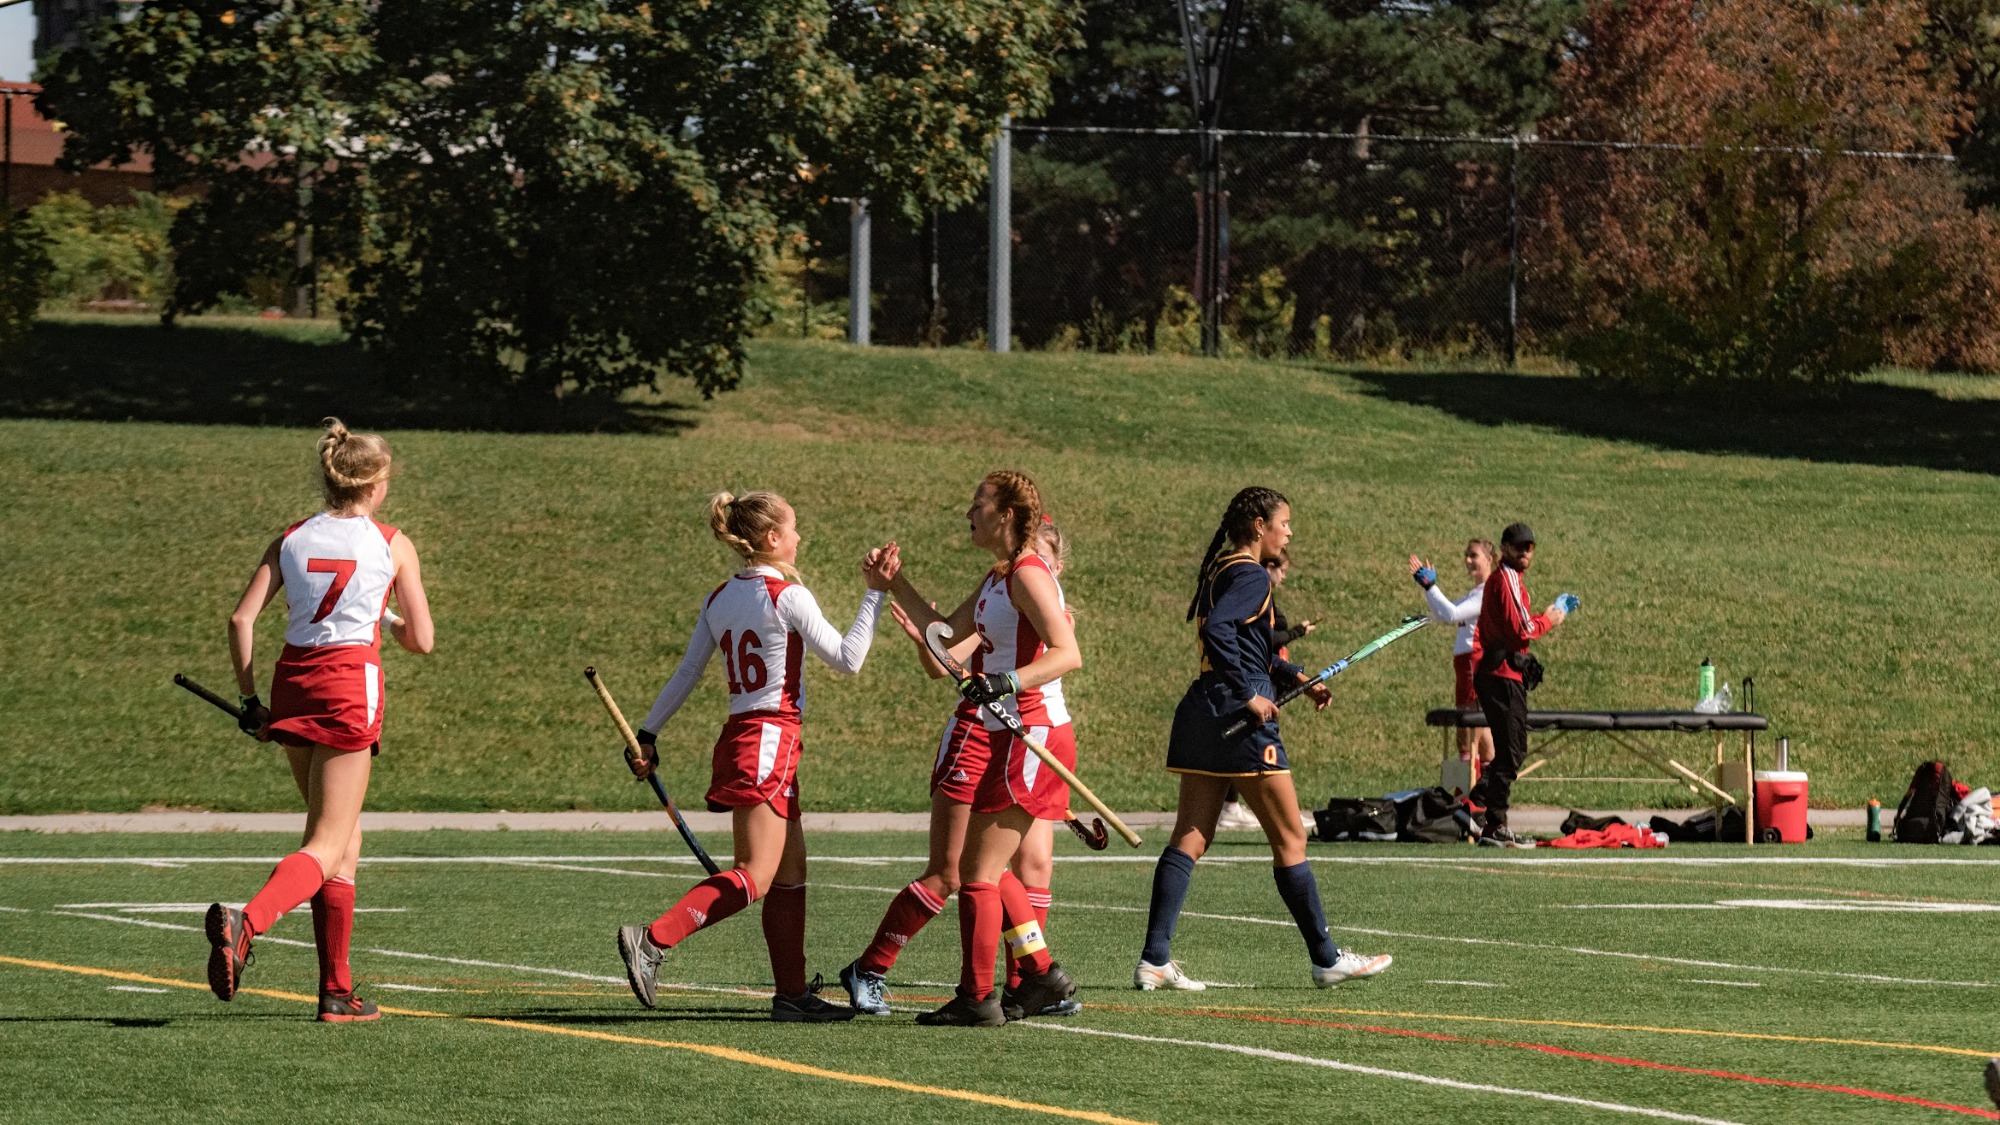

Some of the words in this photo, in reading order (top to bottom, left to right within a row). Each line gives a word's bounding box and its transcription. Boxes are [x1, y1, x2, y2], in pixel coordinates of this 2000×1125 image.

[307, 557, 357, 624] 7
[719, 629, 768, 694] 16
[1263, 743, 1278, 766] Q
